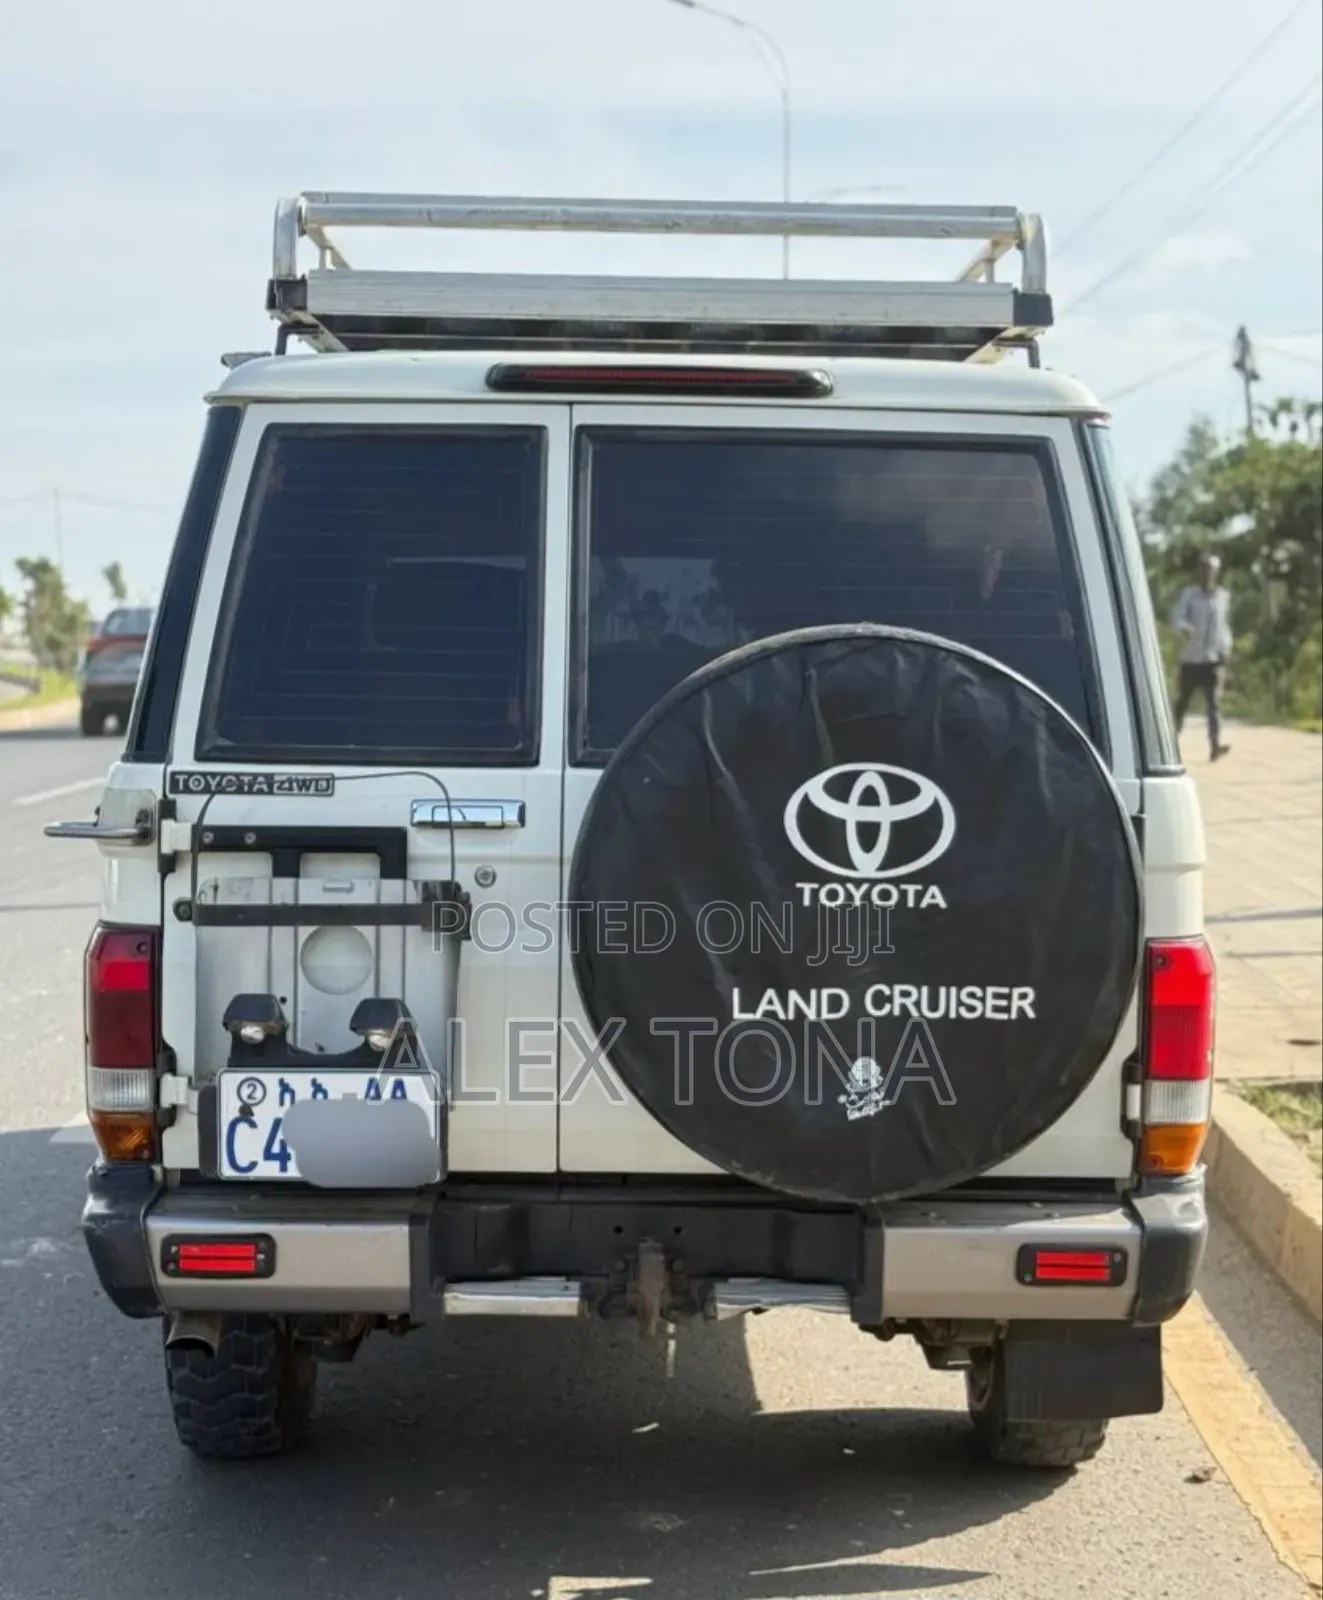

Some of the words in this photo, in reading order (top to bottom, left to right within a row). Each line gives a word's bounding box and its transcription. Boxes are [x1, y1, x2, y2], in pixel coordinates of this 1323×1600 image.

[174, 774, 269, 793] TOYOTA
[274, 775, 332, 794] 4WD
[795, 882, 948, 909] TOYOTA
[731, 987, 850, 1021] LAND
[864, 984, 1037, 1021] CRUISER
